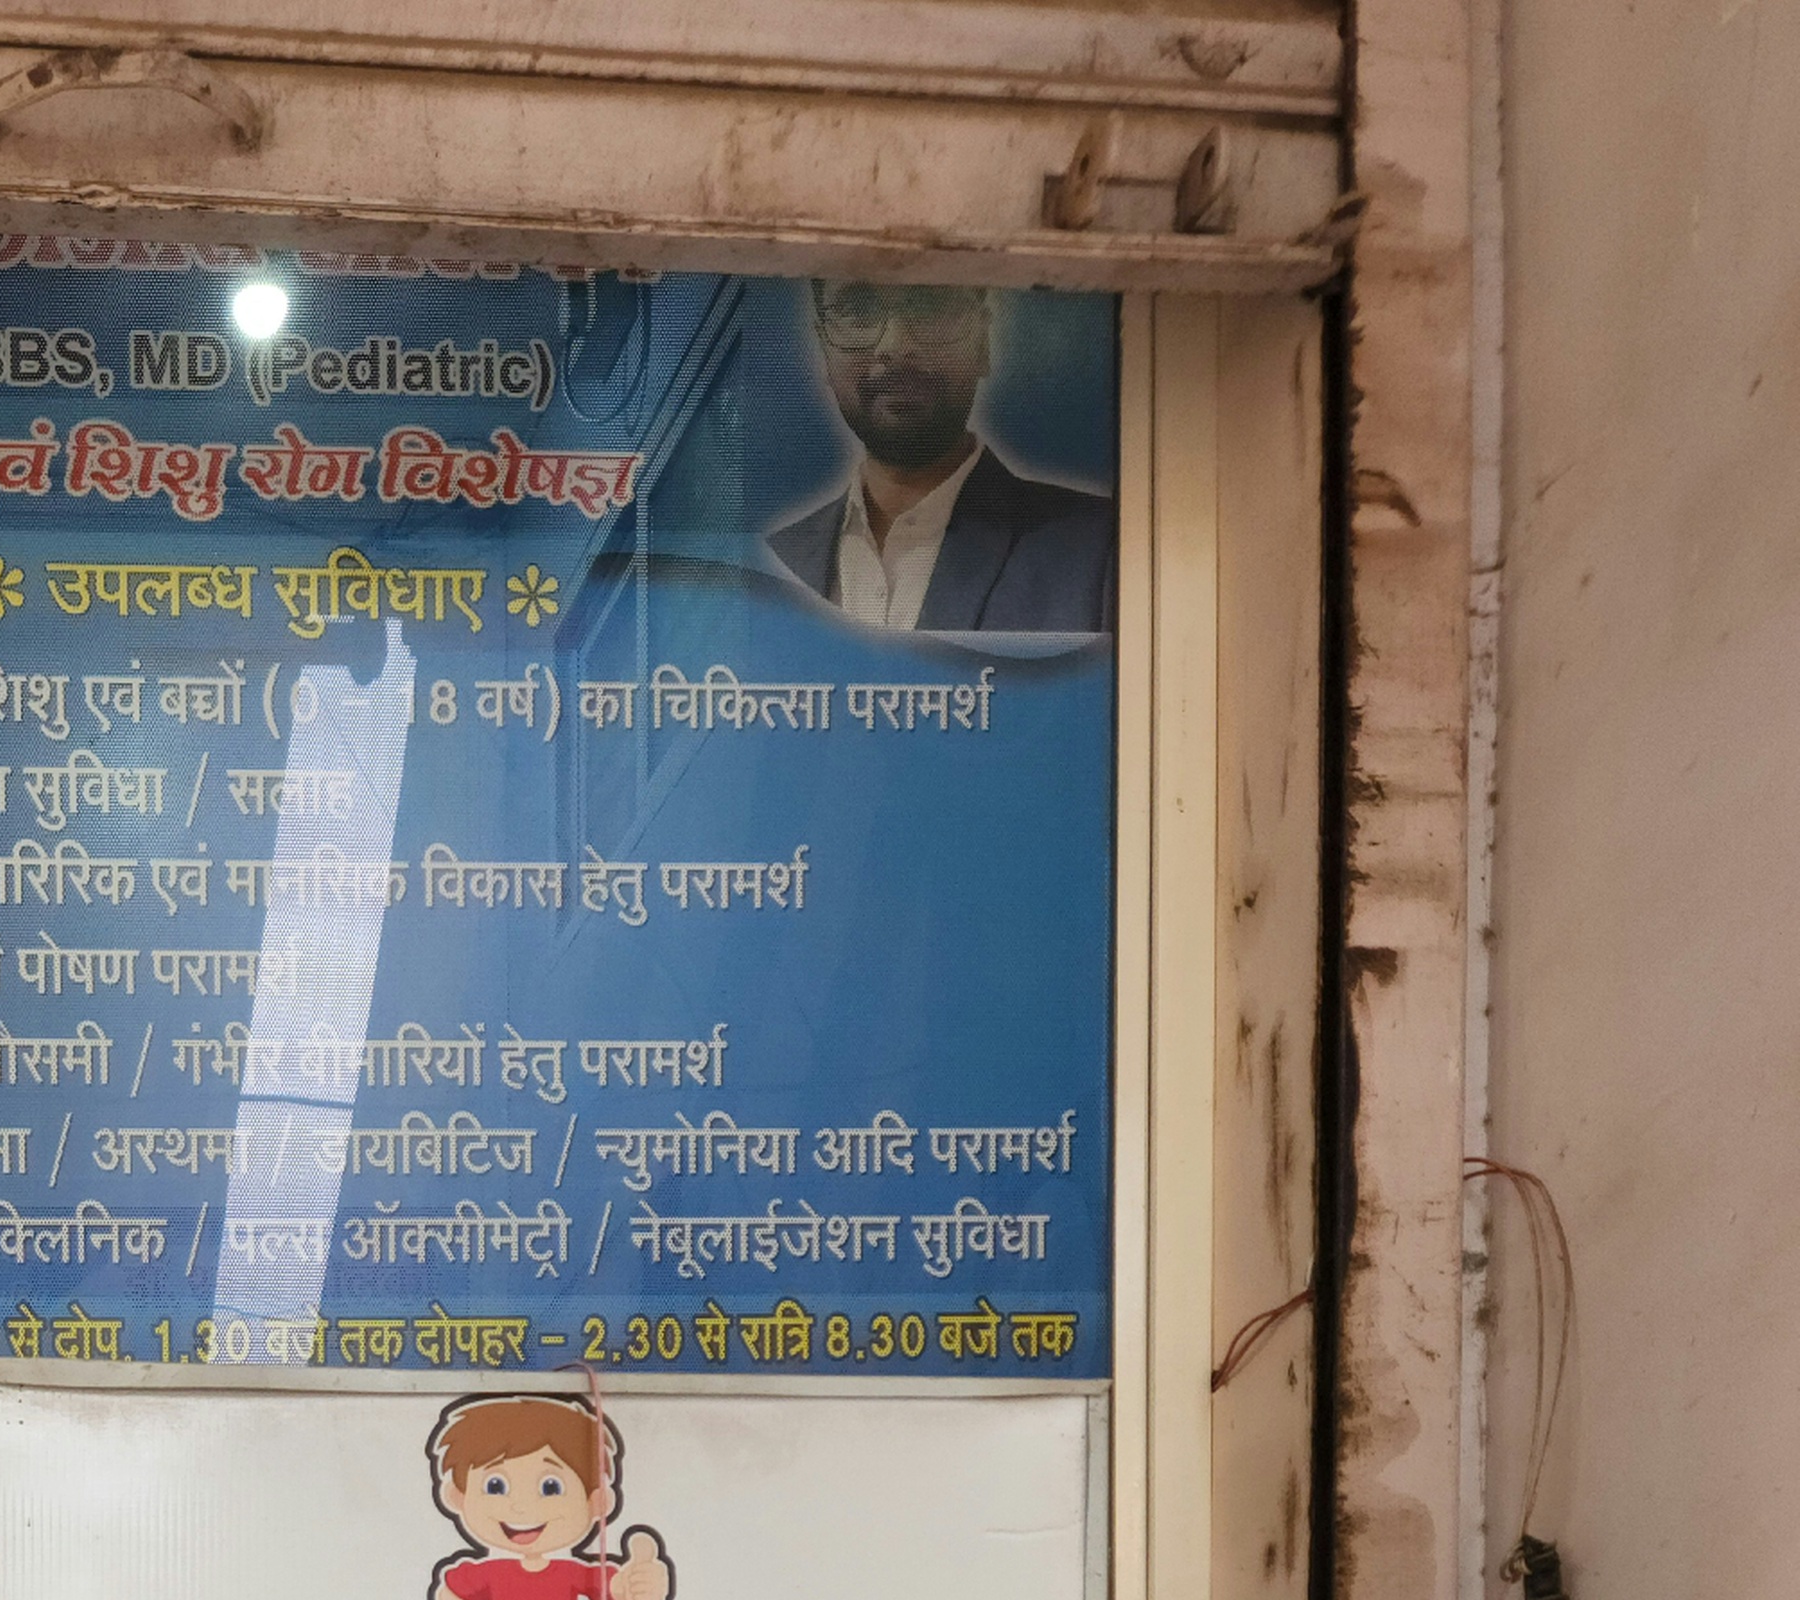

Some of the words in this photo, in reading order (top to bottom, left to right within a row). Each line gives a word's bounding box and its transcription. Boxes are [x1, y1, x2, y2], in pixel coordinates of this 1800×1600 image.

[130, 332, 230, 390] MD
[246, 328, 554, 407] (Pediatric)
[62, 418, 234, 522] शिशु
[240, 424, 373, 502] रोग
[378, 428, 644, 518] विशेषज्ञ
[46, 562, 258, 620] उपलब्ध
[82, 660, 146, 733] एवं
[578, 681, 638, 730] का
[651, 664, 836, 730] चिकित्सा
[846, 667, 995, 731] परामर्श
[24, 750, 168, 830] सुविधा
[150, 843, 214, 915] एवं
[421, 843, 566, 908] विकास
[580, 847, 650, 926] हेतु
[660, 846, 810, 909] परामर्श
[17, 931, 140, 996] पोषण
[500, 1023, 568, 1104] हेतु
[580, 1024, 729, 1089] परामर्श
[812, 1110, 917, 1174] आदि
[930, 1110, 1077, 1174] परामर्श
[911, 1196, 1051, 1278] सुविधा
[7, 1305, 43, 1360] से
[338, 1319, 406, 1363] तक
[414, 1303, 528, 1366] दोपहर
[582, 1317, 681, 1362] 2.30
[695, 1301, 731, 1360] से
[738, 1300, 814, 1358] रात्रि
[826, 1315, 925, 1362] 8.30
[937, 1300, 1003, 1360] बजे
[1009, 1313, 1076, 1357] तक
